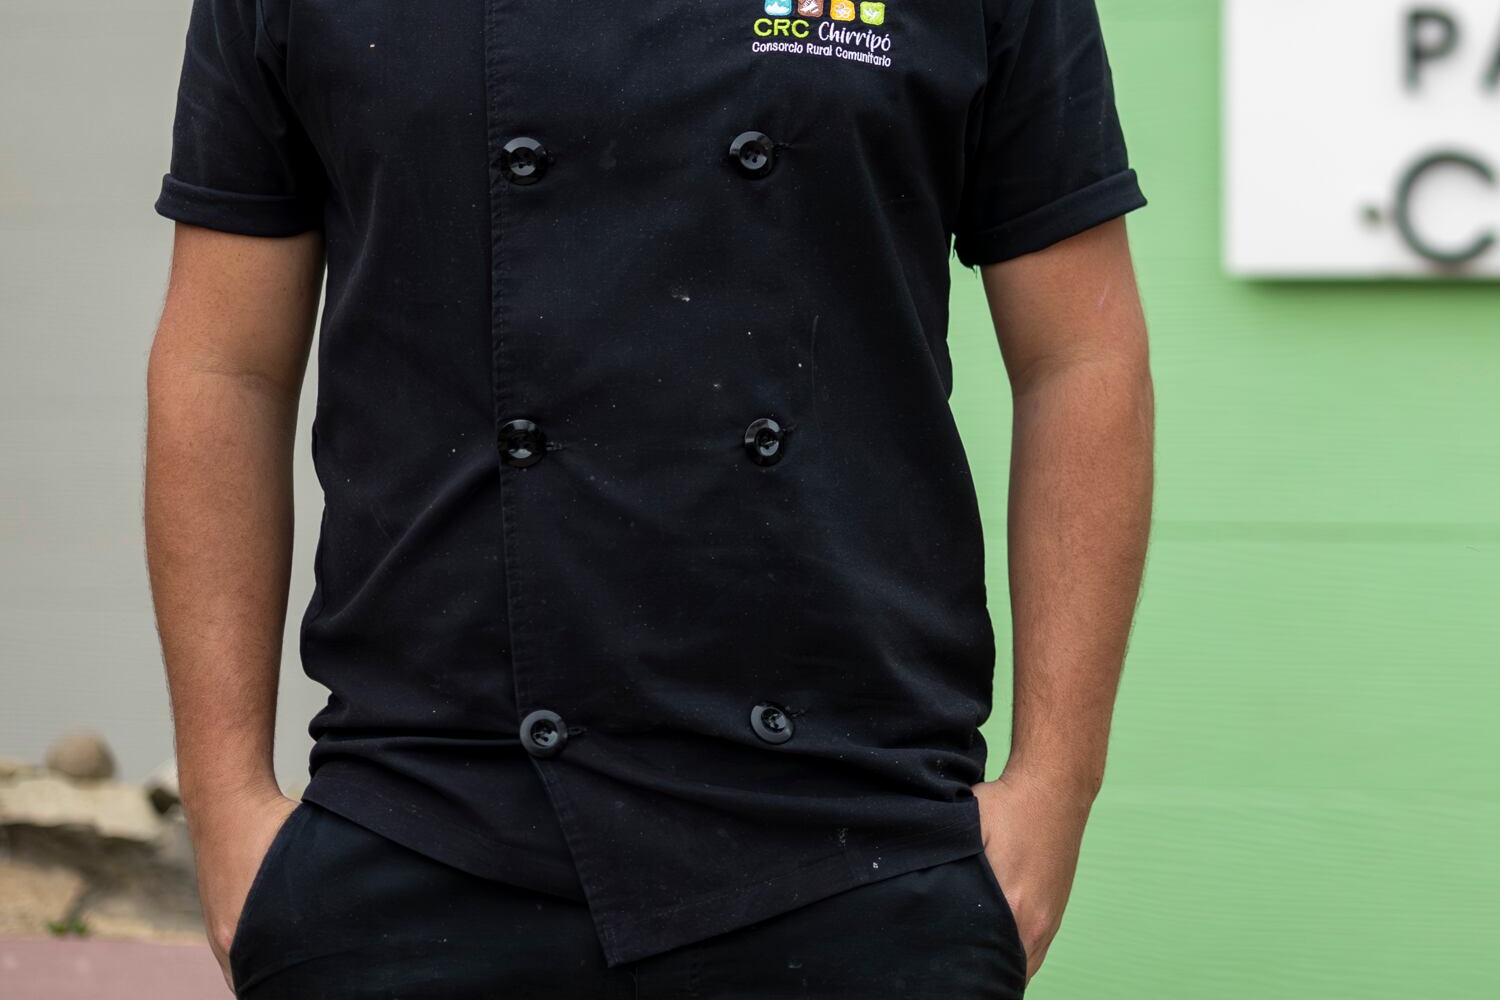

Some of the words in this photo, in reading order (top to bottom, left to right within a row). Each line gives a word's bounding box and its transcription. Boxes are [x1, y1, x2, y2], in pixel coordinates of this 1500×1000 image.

[753, 18, 810, 38] CRC
[818, 21, 891, 52] Chirripó
[752, 41, 803, 54] Consorcio
[806, 43, 832, 56] Rural
[835, 47, 891, 67] Comunitario
